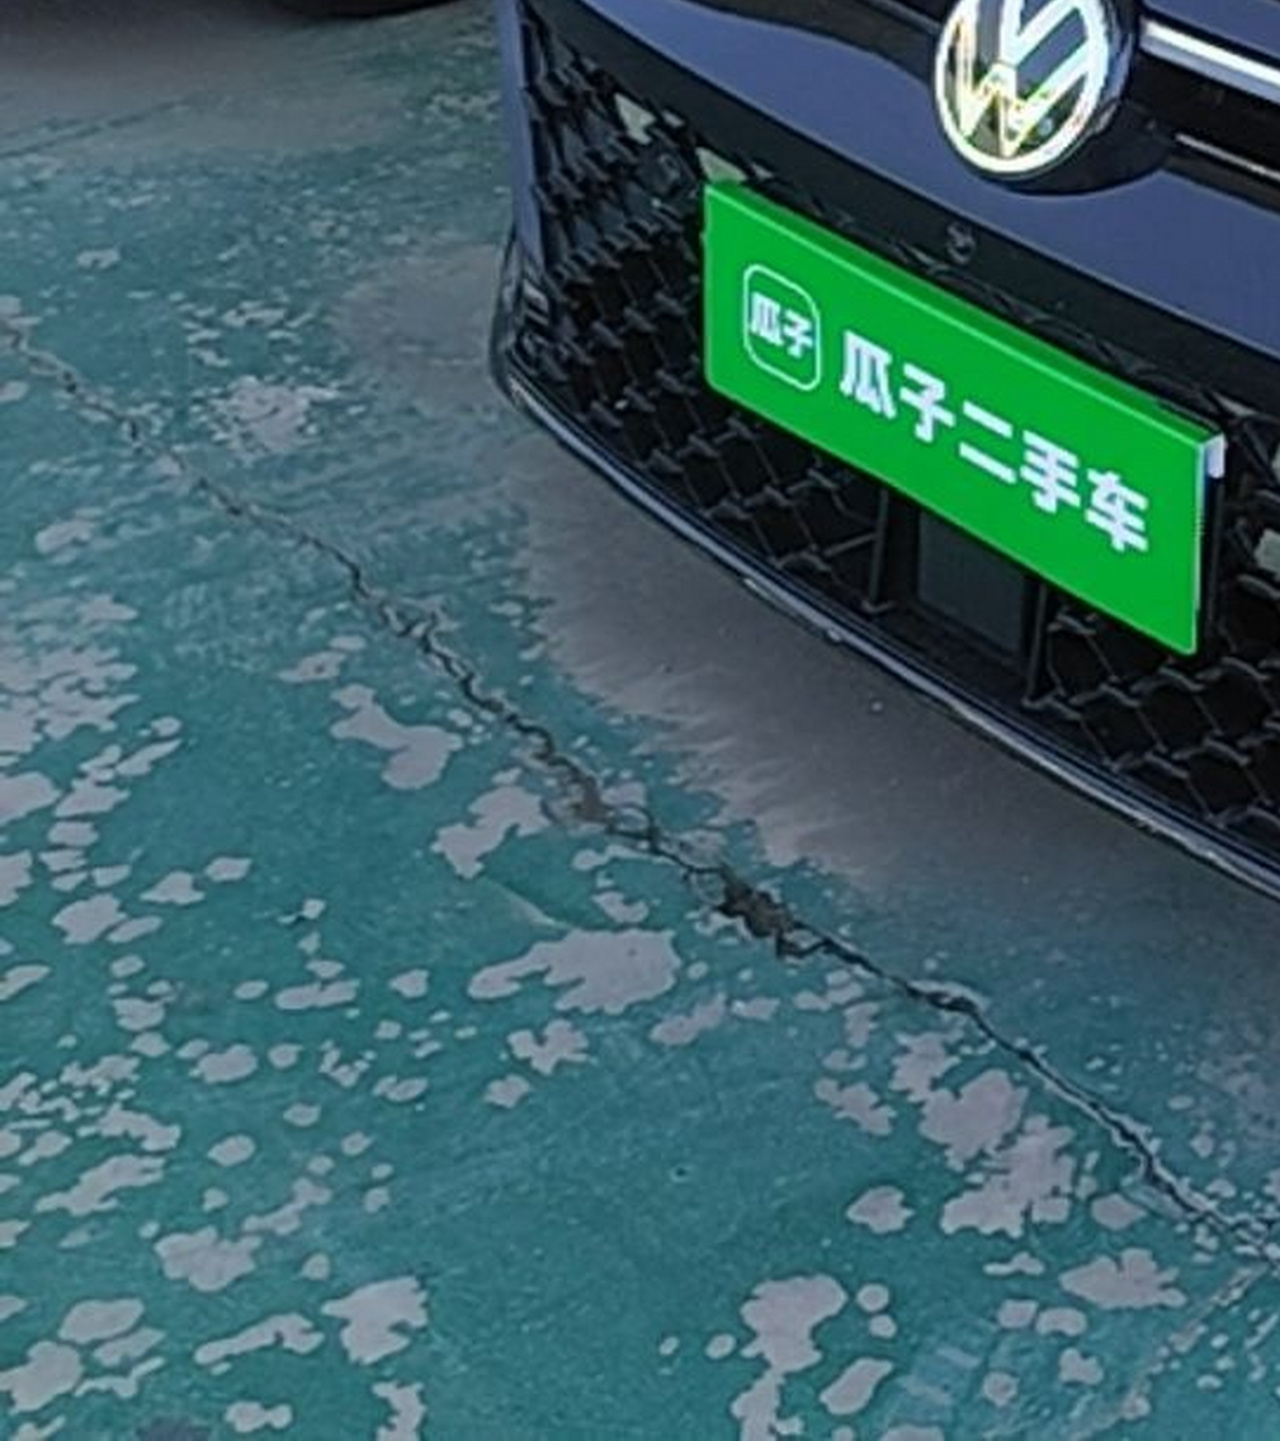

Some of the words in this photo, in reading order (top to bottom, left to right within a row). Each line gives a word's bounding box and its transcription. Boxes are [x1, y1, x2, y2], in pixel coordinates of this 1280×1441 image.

[748, 292, 816, 360] 瓜子
[838, 329, 1151, 556] 瓜子二手车
